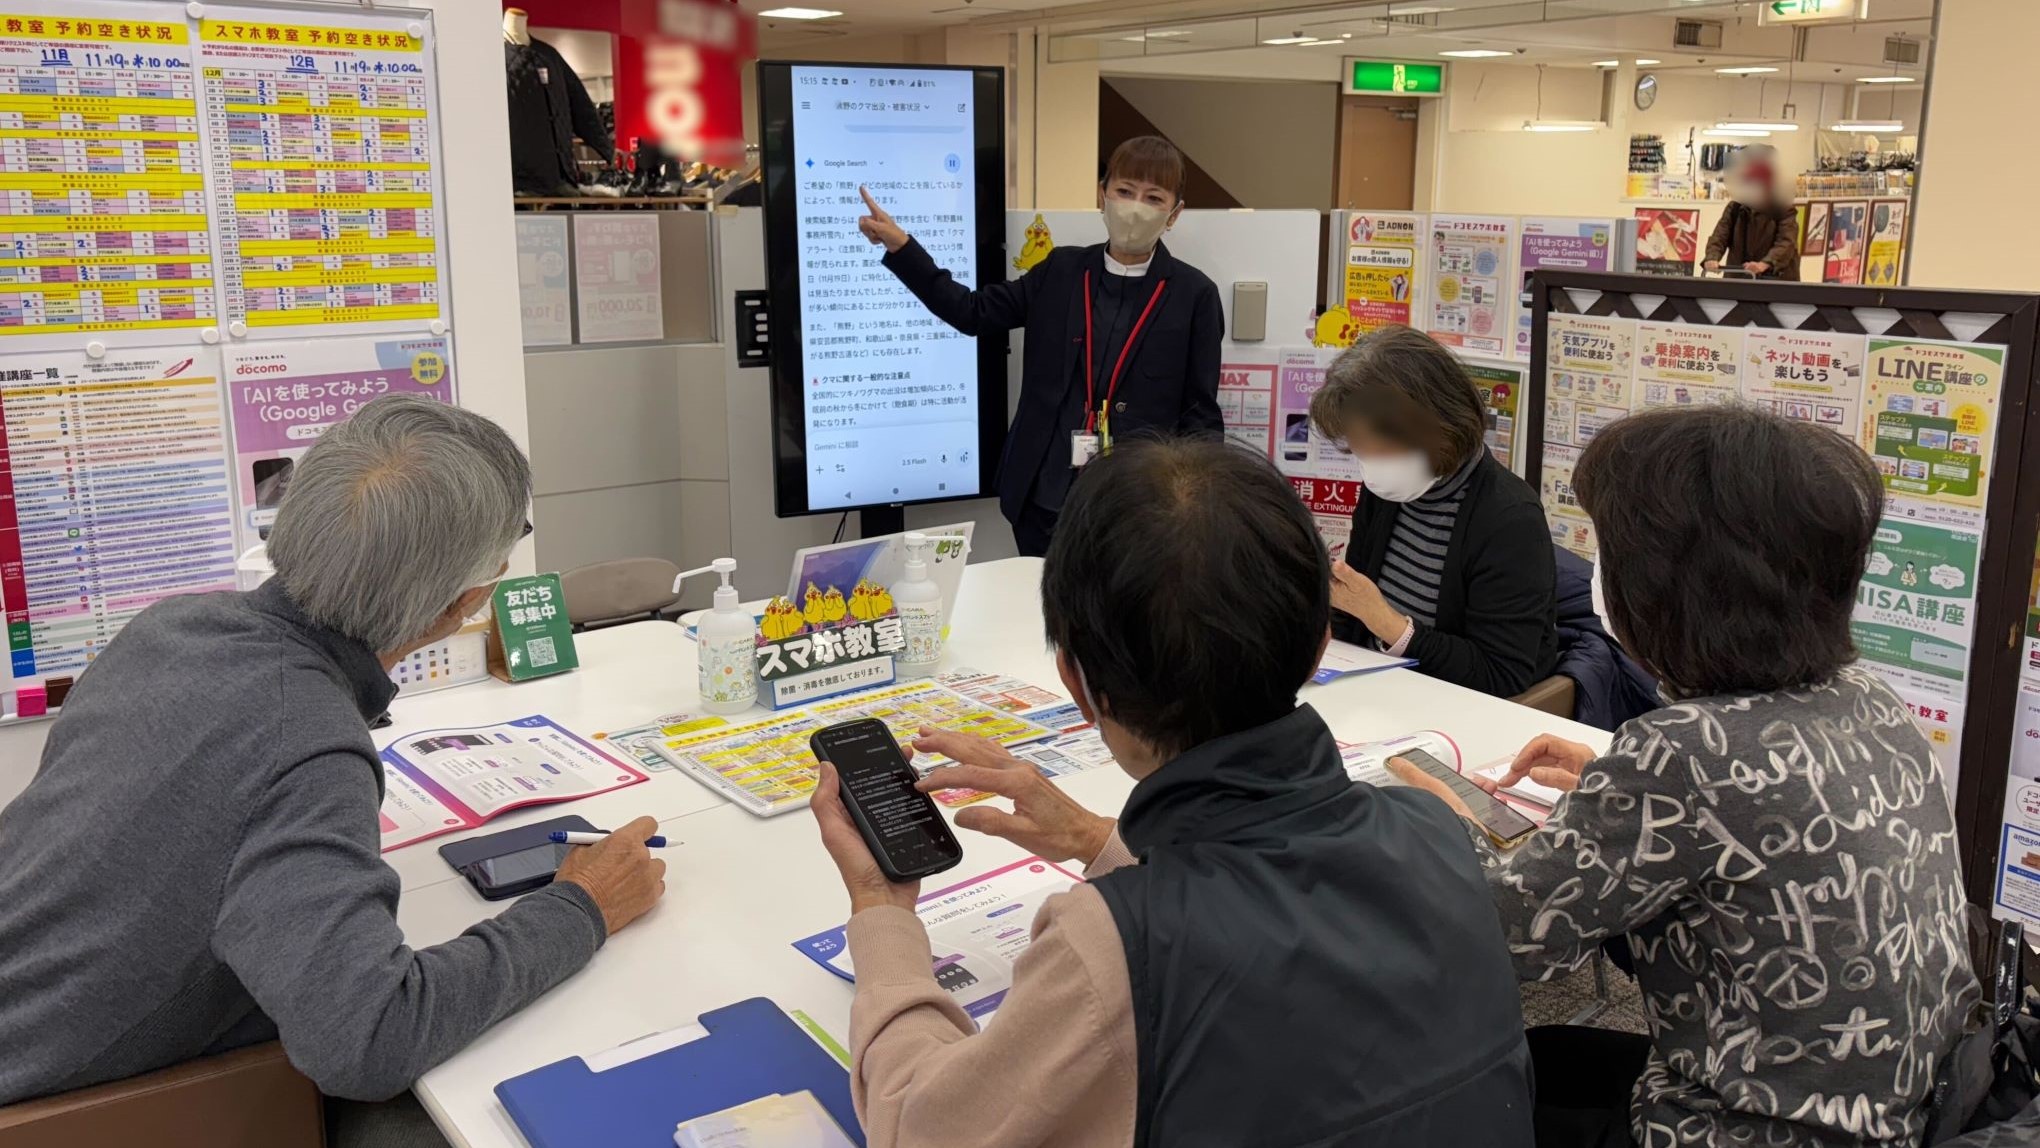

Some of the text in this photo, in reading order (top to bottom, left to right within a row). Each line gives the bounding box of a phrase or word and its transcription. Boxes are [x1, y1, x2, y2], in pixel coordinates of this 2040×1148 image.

[55, 21, 173, 40] 予約空き状況
[216, 24, 408, 49] スマホ教室 予約空き状況
[800, 77, 818, 86] 15:15
[824, 160, 868, 169] Google Search
[1562, 335, 1616, 351] 天気アプリを
[1655, 342, 1720, 361] 乗換案内を
[1563, 346, 1613, 361] 便利に使おう
[1765, 349, 1842, 369] ネット動画を
[236, 363, 287, 375] docomo
[1658, 358, 1715, 372] 便利に使おう
[1774, 365, 1829, 382] 楽しもう
[1946, 363, 1965, 371] ライン
[243, 377, 389, 404] 「AIを使ってみよう
[1915, 382, 1943, 393] ご案内
[504, 585, 552, 607] 友だち
[509, 603, 557, 626] 募集中
[757, 618, 906, 677] スマホ教室
[781, 666, 885, 695] 除菌・消毒を徹底しております。
